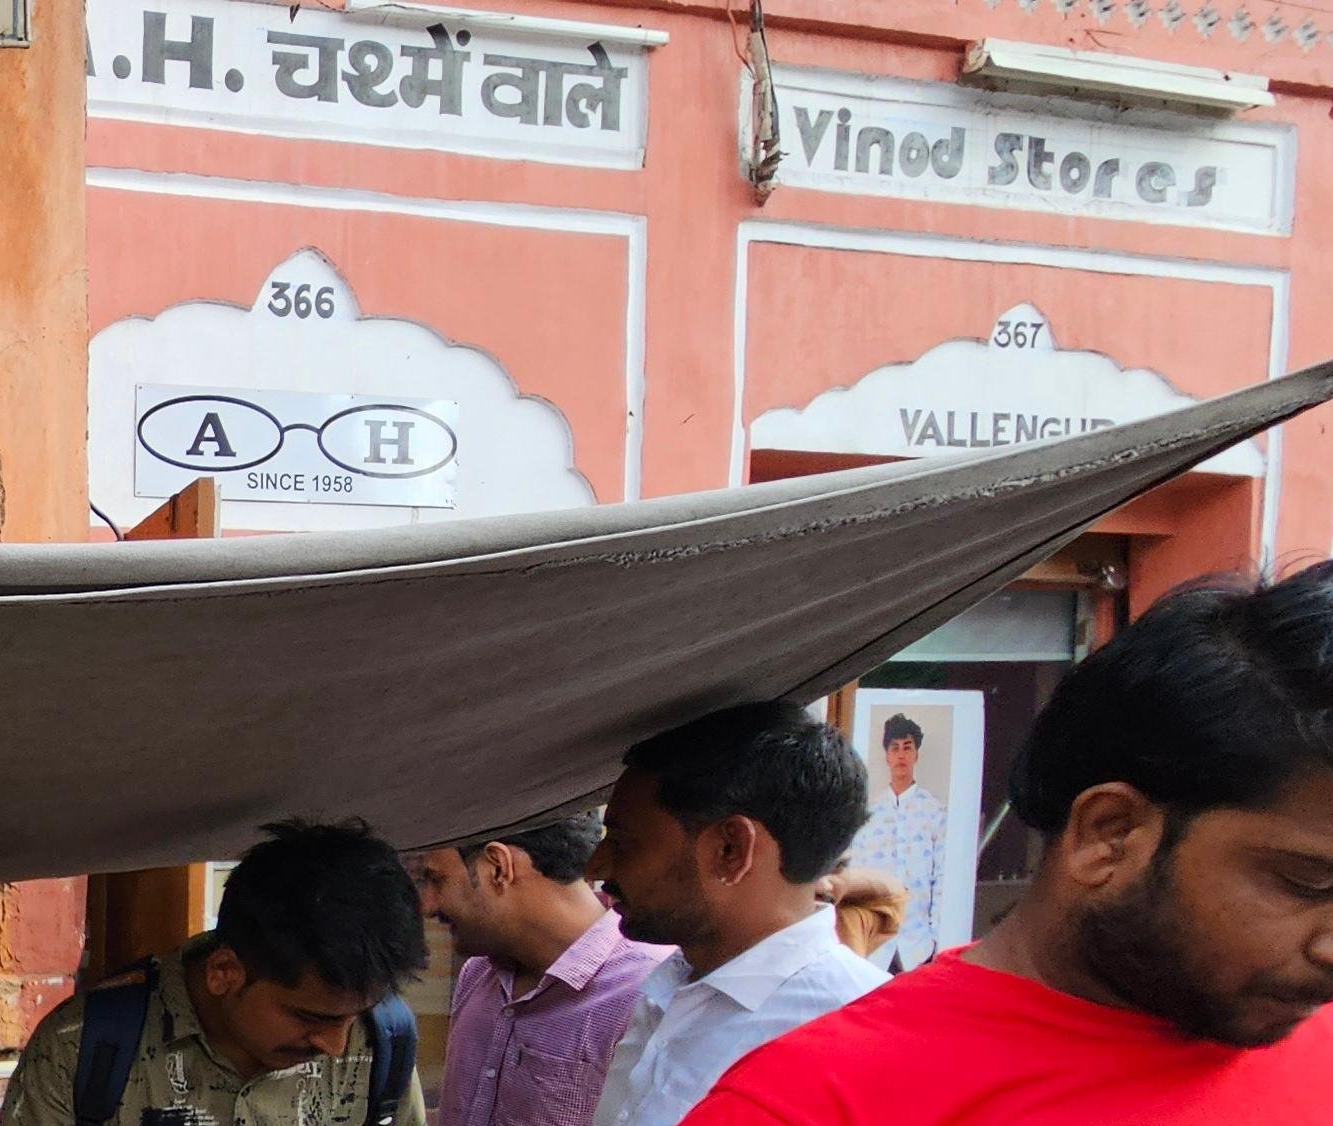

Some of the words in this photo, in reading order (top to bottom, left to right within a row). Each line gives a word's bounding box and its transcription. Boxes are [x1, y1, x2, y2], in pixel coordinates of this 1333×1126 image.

[87, 11, 244, 92] .H.
[481, 41, 628, 132] वाले
[793, 105, 966, 179] Vinod
[988, 132, 1218, 207] Stores
[268, 281, 335, 319] 366
[993, 320, 1044, 349] 367
[186, 413, 237, 457] A
[364, 420, 415, 465] H
[247, 471, 305, 493] SINCE
[312, 474, 353, 494] 1958
